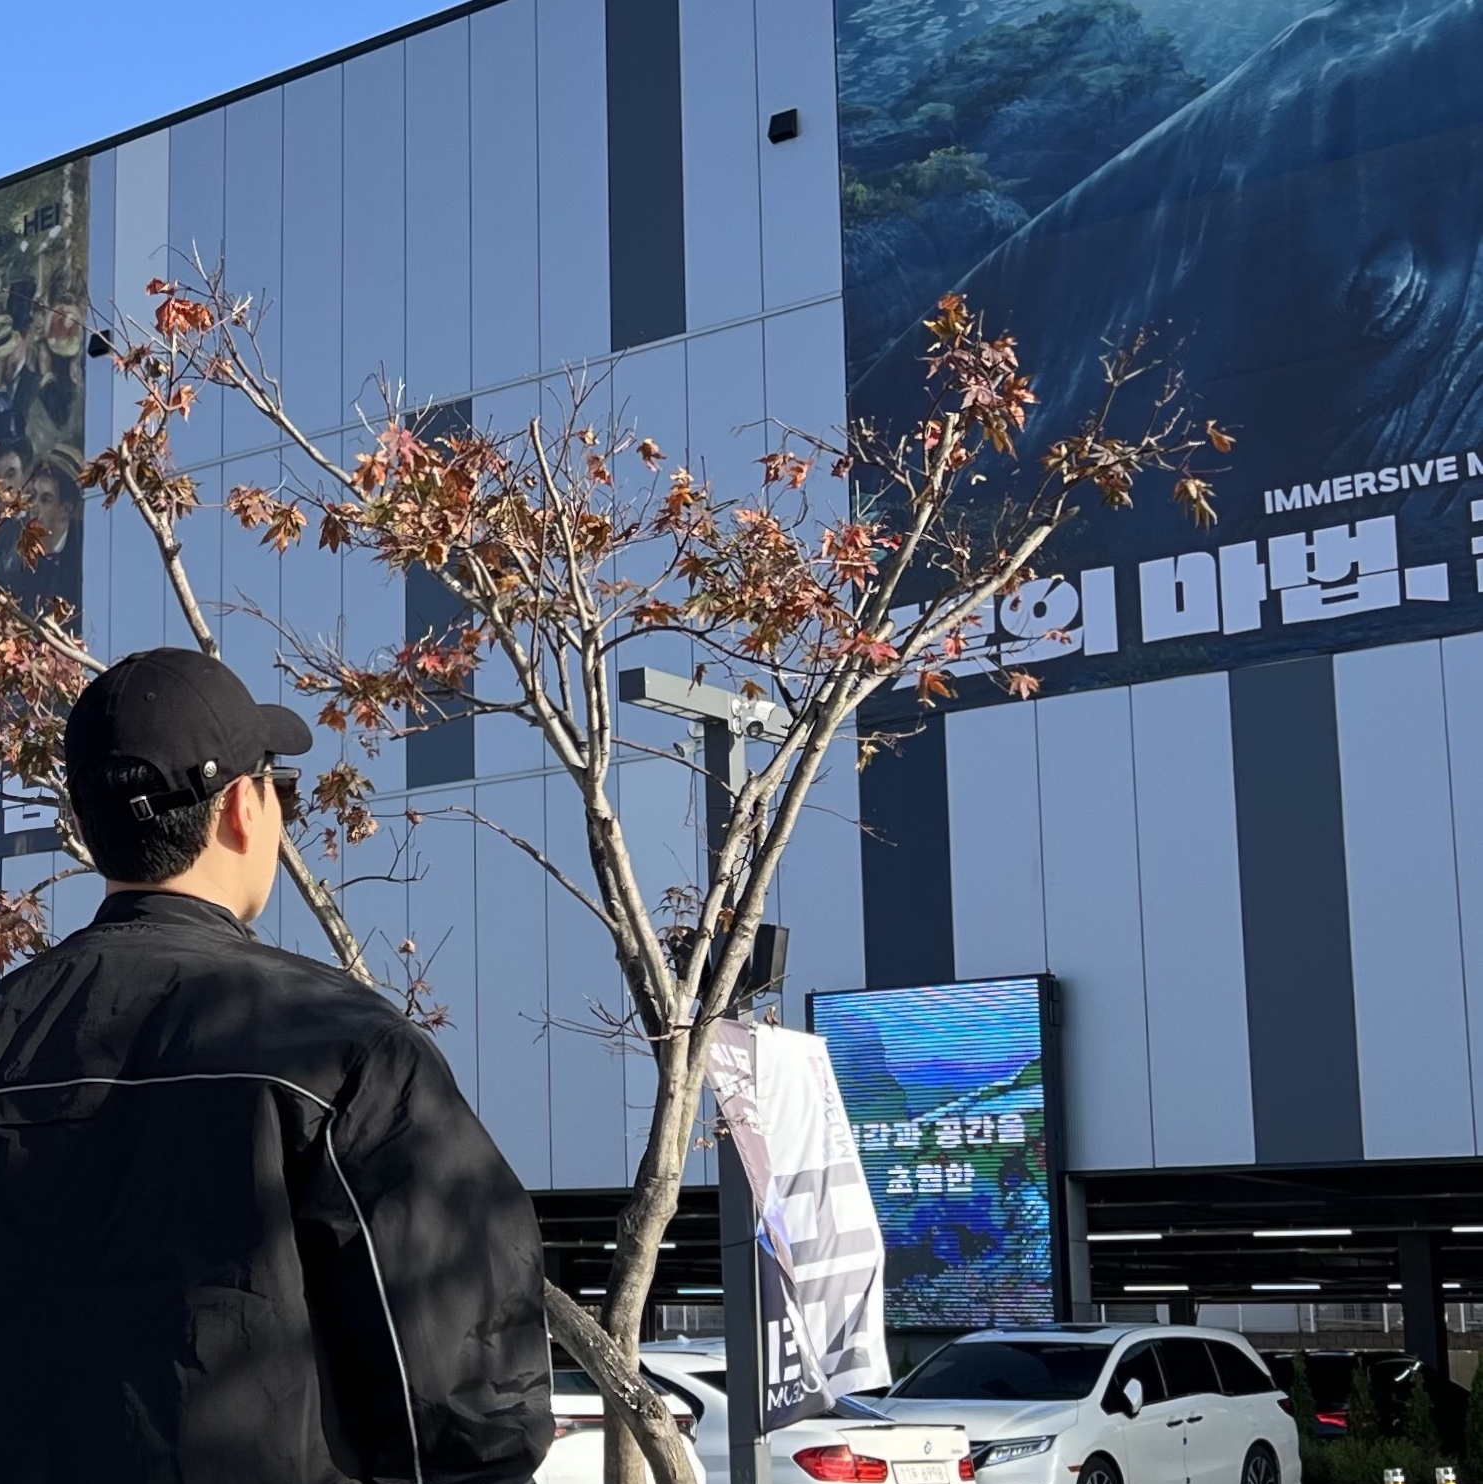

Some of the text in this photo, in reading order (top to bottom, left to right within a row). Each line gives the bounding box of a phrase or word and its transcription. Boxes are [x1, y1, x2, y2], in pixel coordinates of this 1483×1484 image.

[1264, 456, 1459, 514] IMMERSIVE
[851, 1113, 1026, 1151] 간과 공간을
